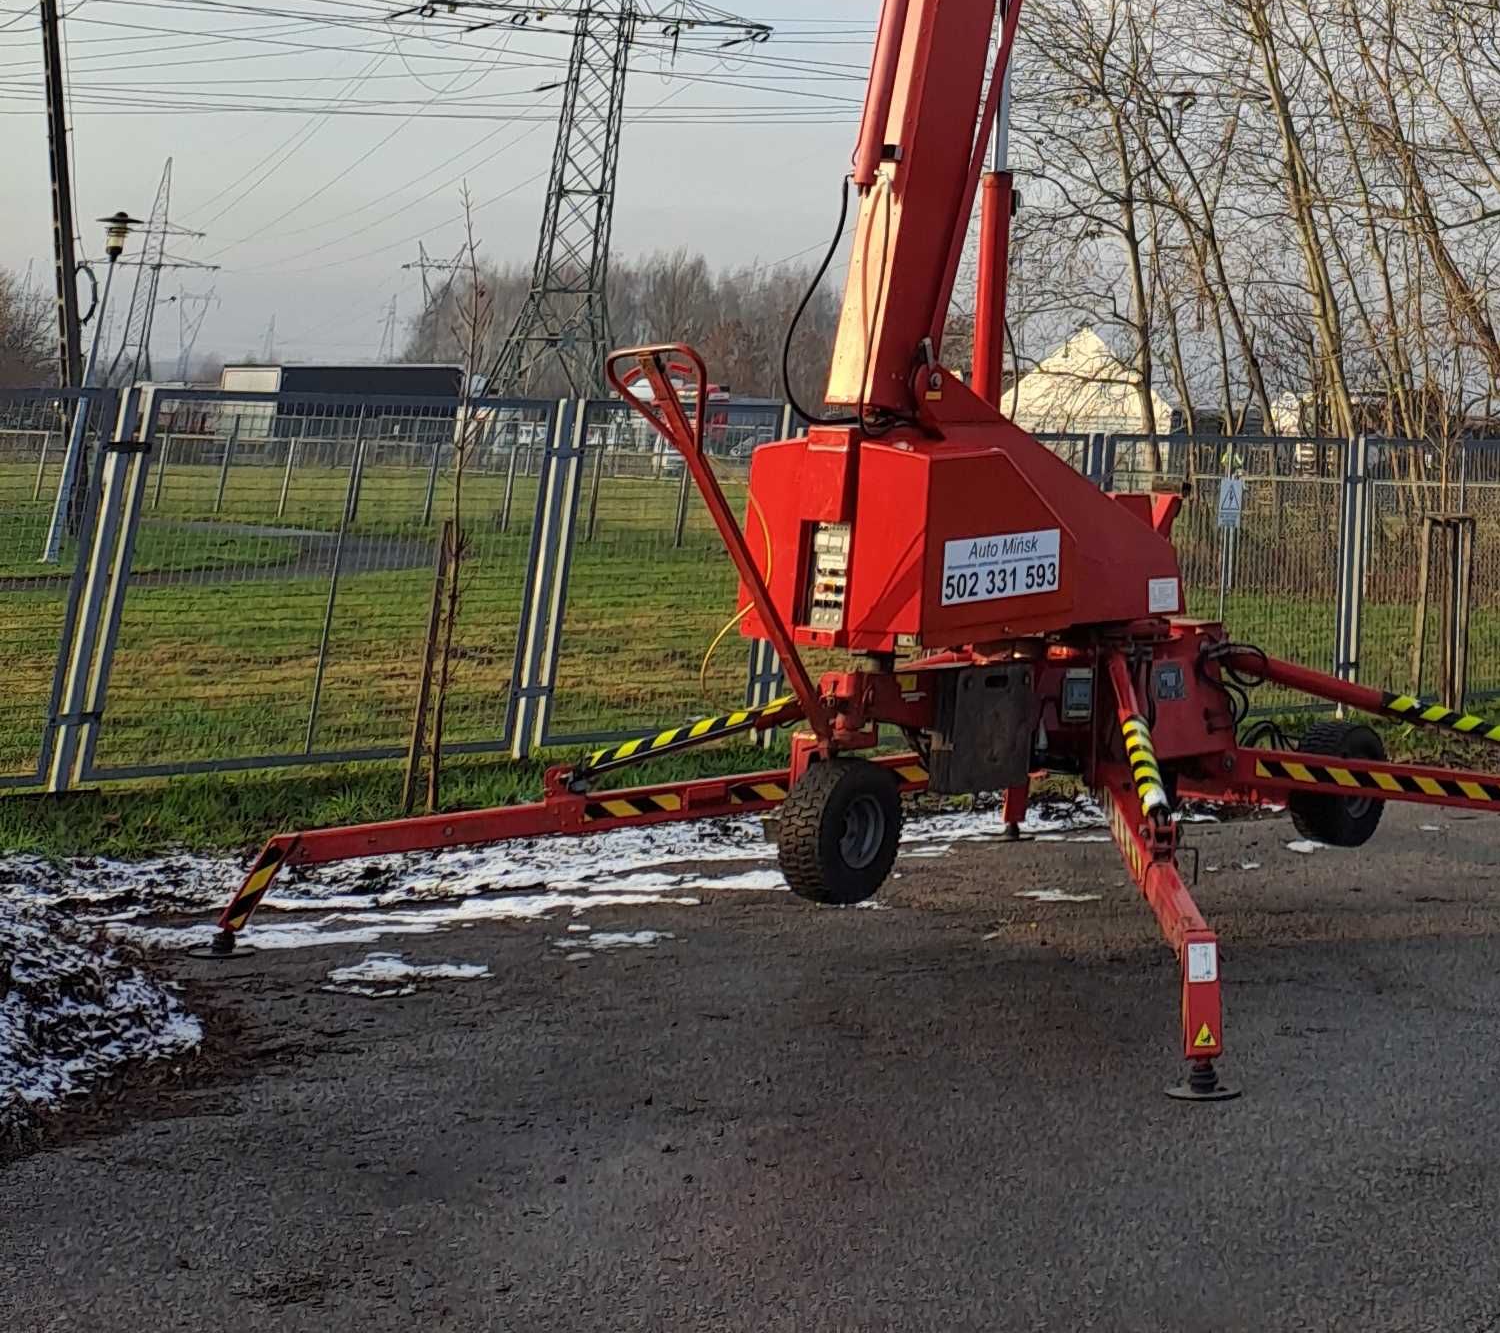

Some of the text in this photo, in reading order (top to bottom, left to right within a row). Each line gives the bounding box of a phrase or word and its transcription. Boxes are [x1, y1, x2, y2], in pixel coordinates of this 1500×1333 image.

[968, 535, 1039, 560] Auto Mińsk
[944, 572, 979, 600] 502
[985, 566, 1017, 595] 331
[1025, 562, 1057, 590] 593
